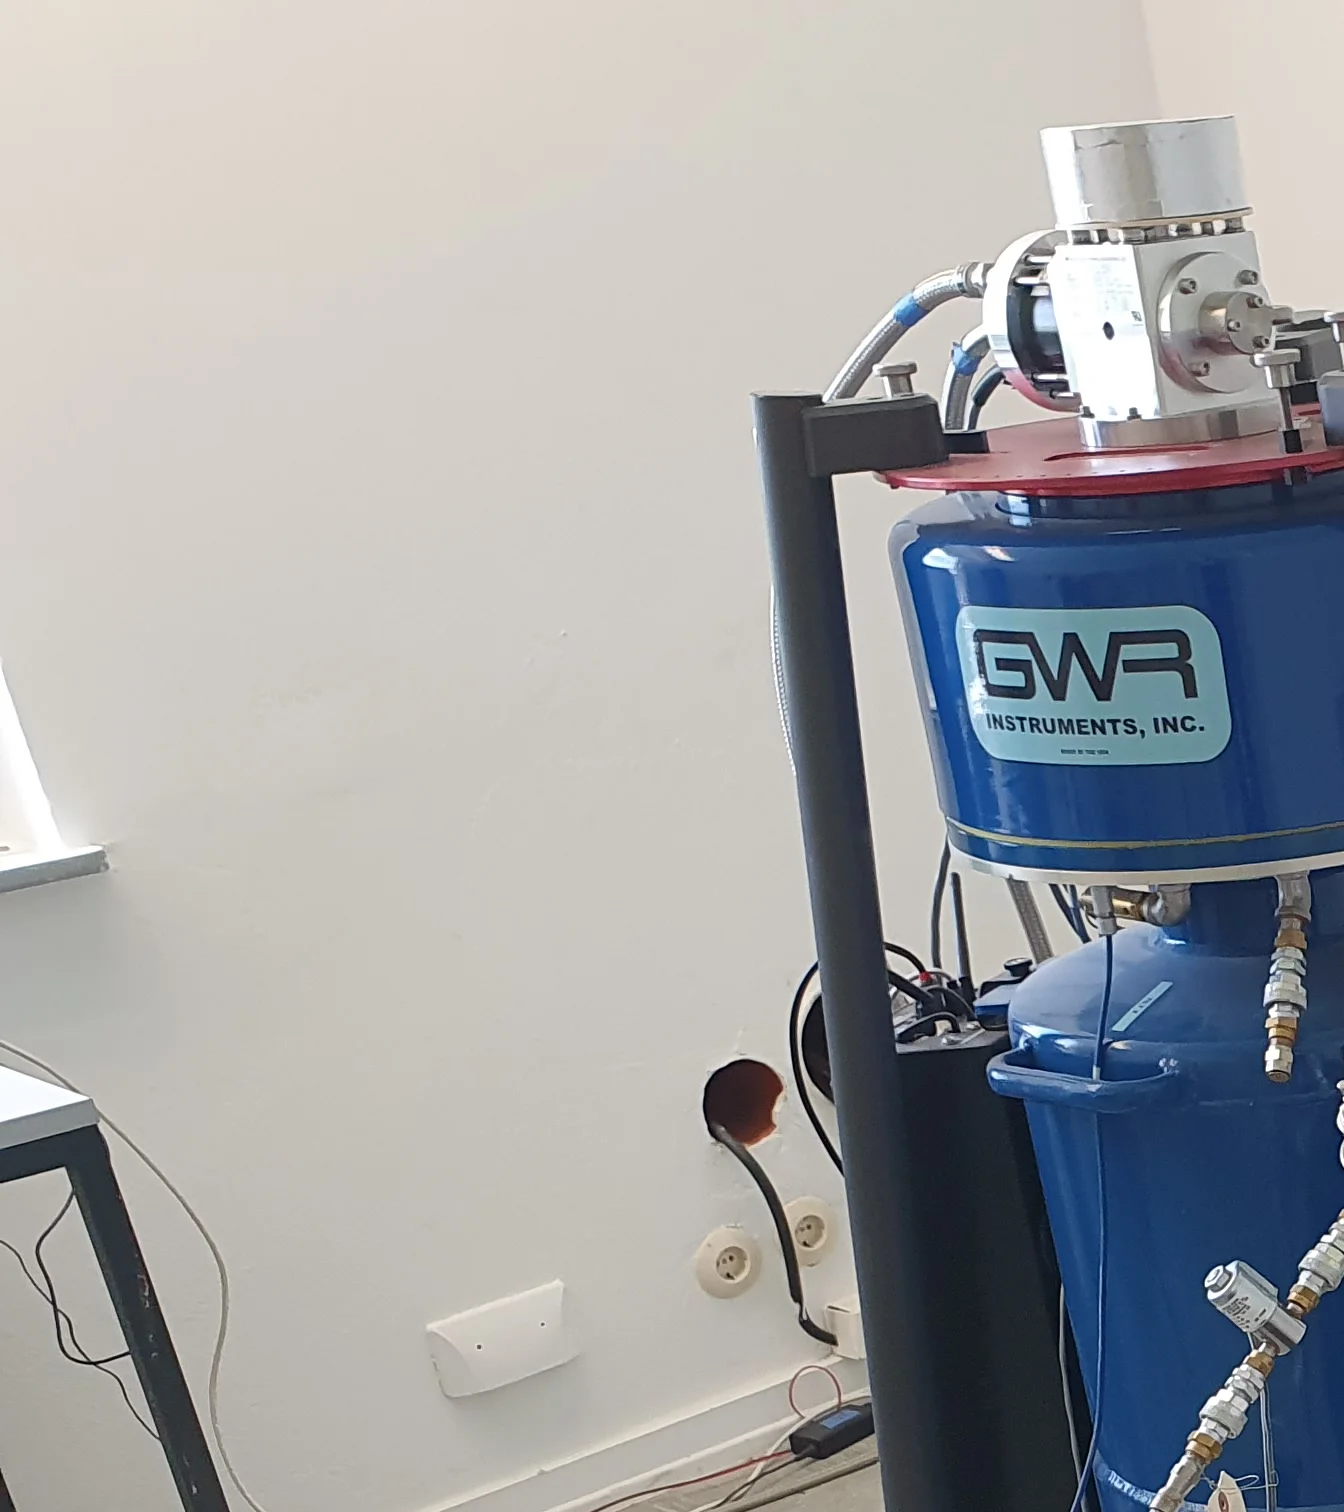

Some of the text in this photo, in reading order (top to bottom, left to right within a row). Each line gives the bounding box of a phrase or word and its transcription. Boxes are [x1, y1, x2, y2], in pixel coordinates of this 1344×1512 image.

[973, 629, 1198, 701] GWR
[986, 713, 1205, 739] INSTRUMENTS, INC.
